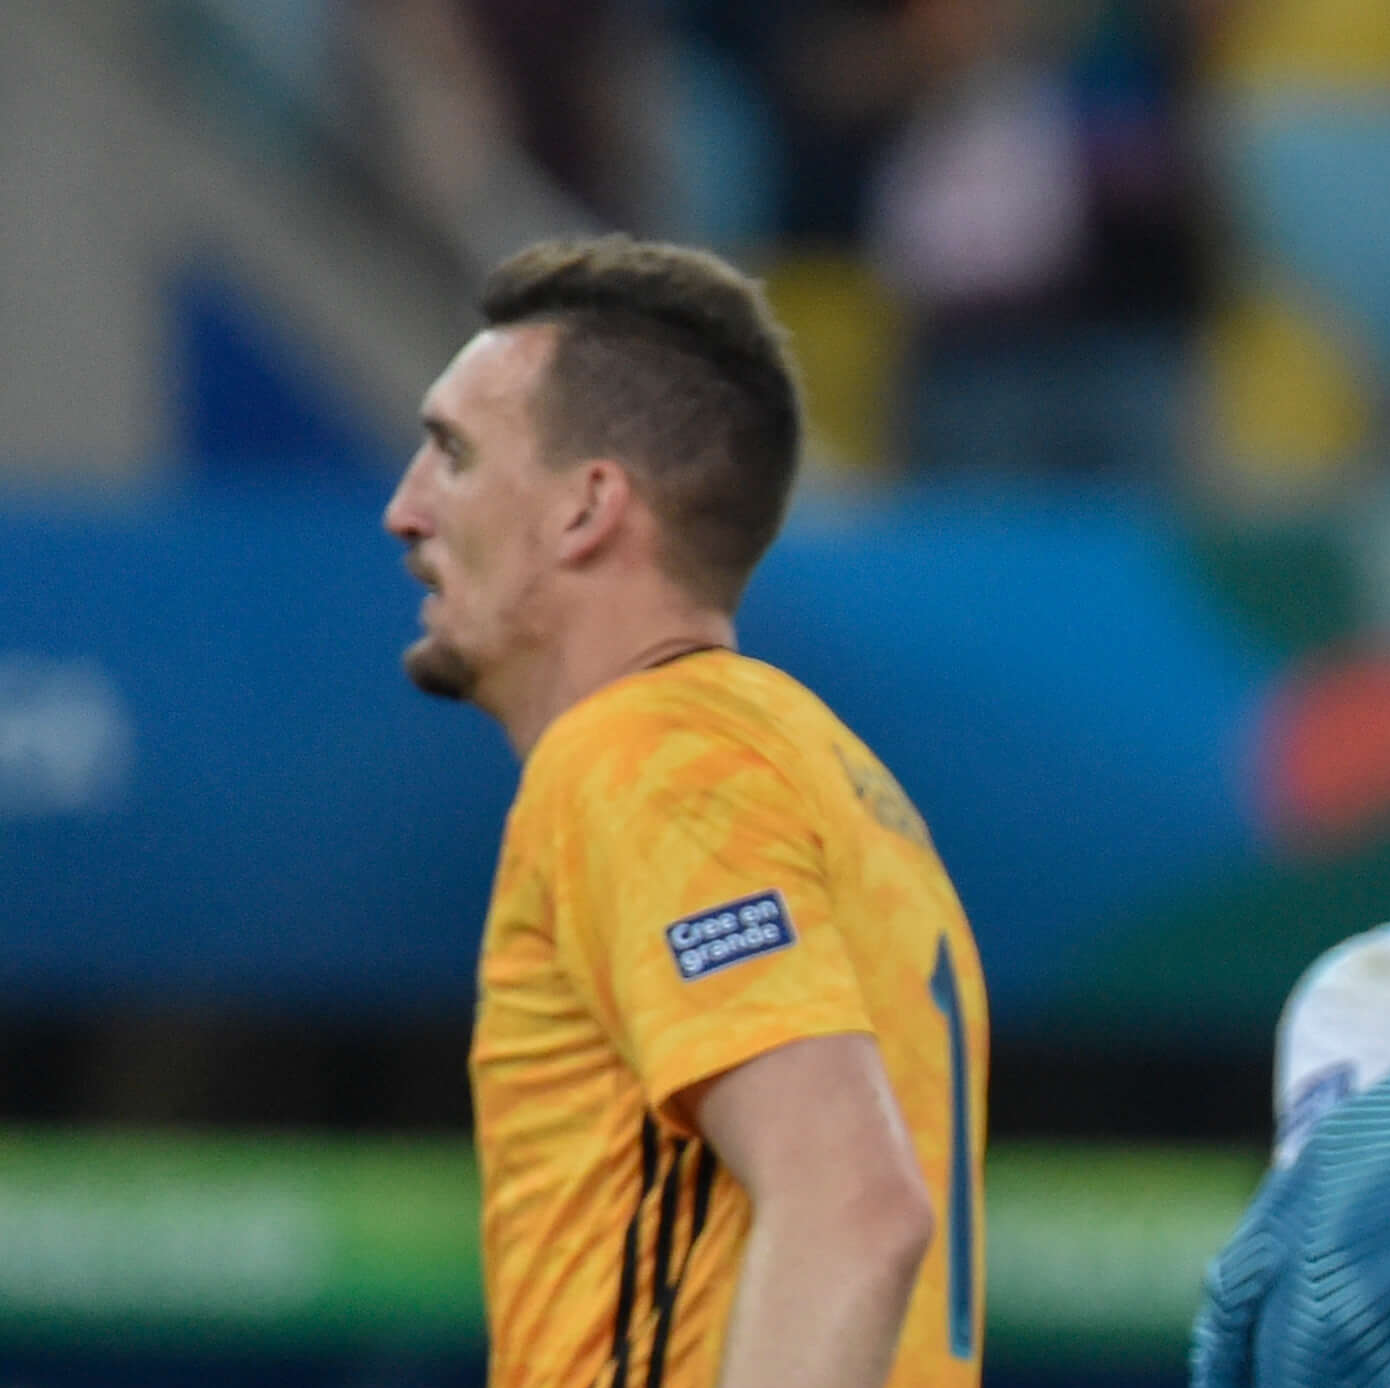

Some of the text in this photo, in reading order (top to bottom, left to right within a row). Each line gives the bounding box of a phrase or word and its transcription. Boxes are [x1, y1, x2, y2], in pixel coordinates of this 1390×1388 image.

[671, 900, 779, 950] Cree en
[680, 922, 781, 974] grande
[928, 931, 976, 1362] 1
